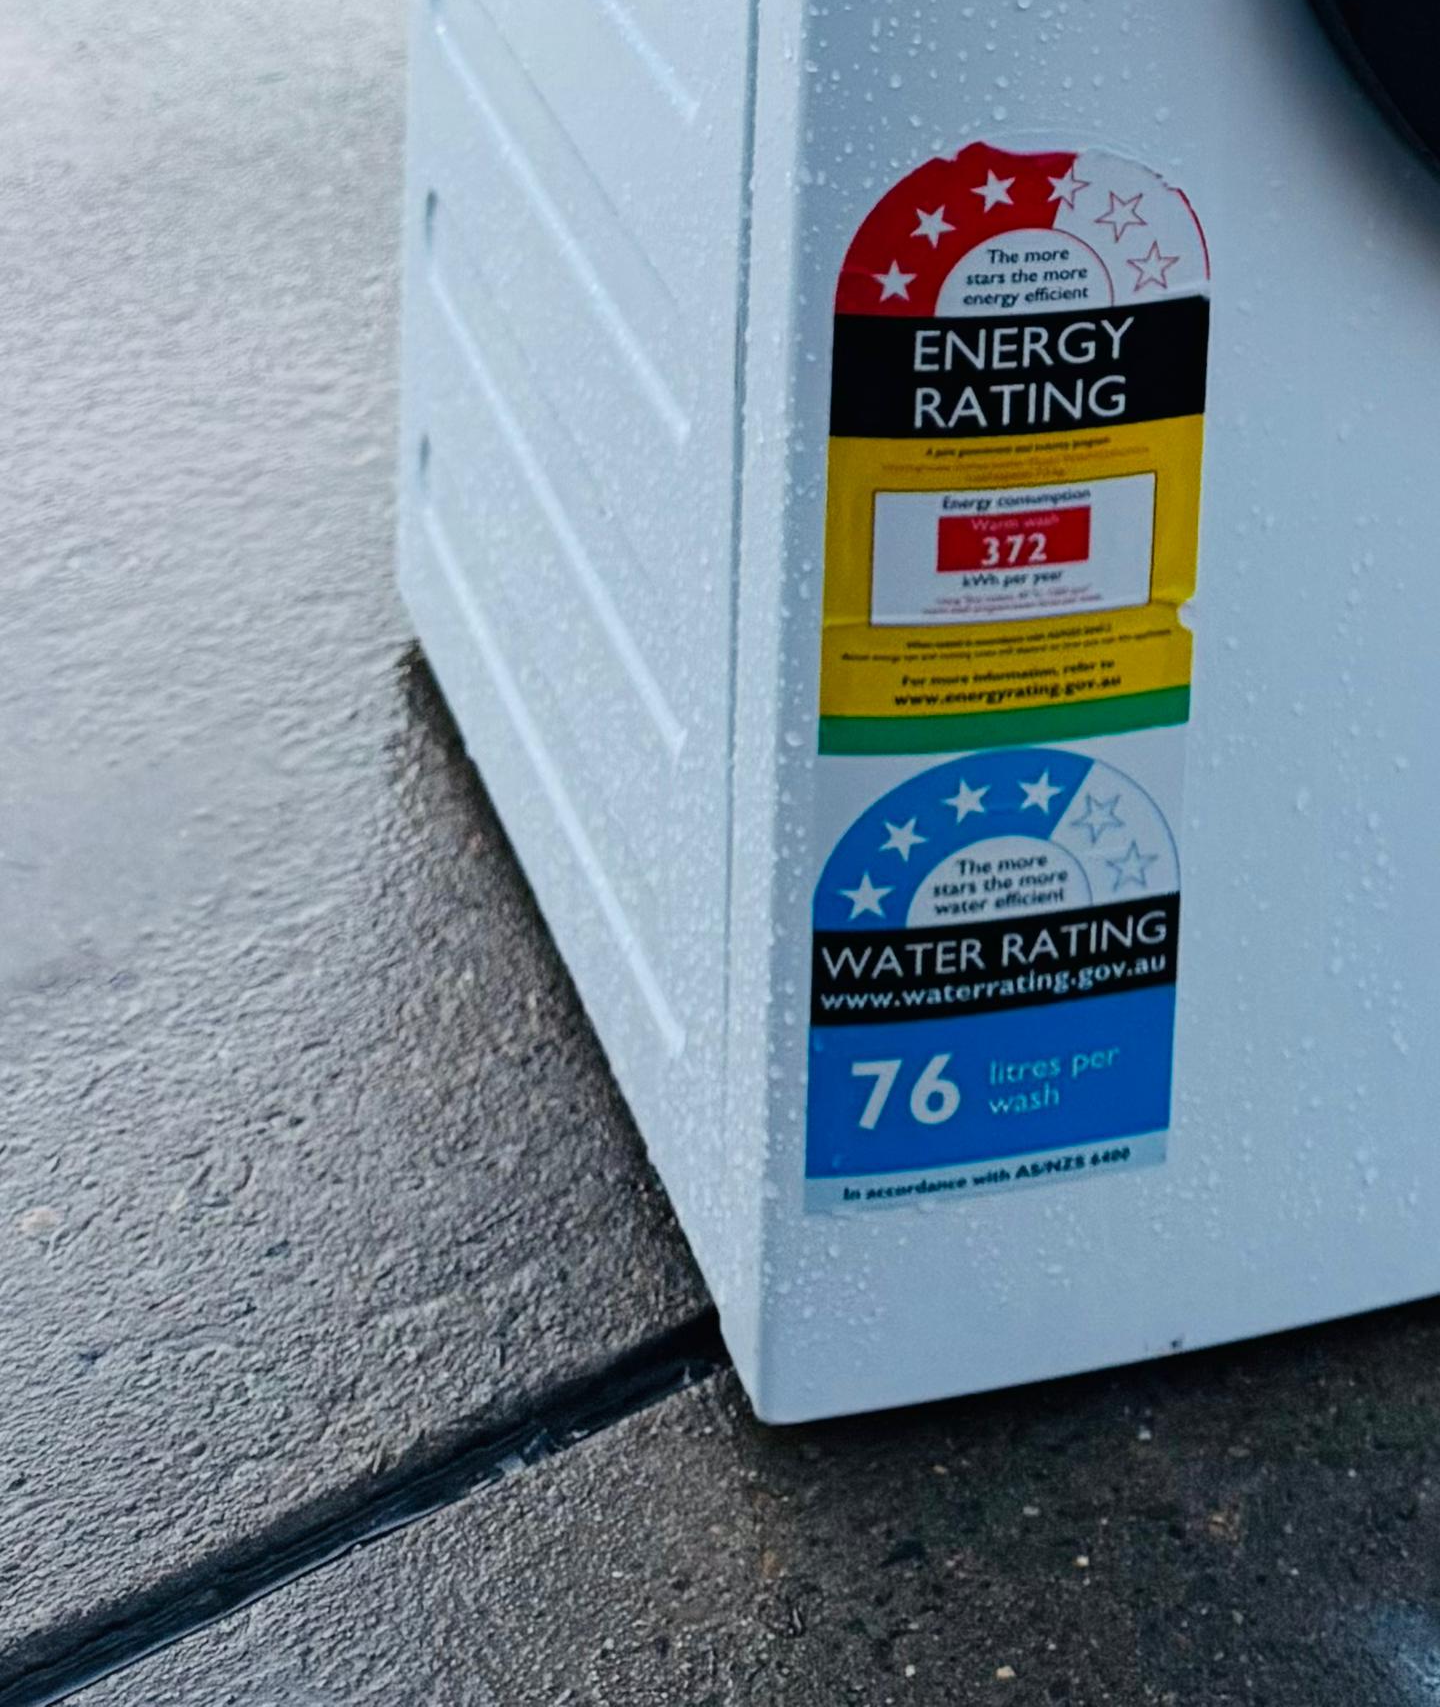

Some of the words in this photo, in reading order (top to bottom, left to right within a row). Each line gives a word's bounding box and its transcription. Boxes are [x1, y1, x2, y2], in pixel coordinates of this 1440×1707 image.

[986, 248, 1021, 266] The
[1024, 247, 1070, 264] more
[966, 270, 1006, 287] stars
[1010, 268, 1040, 285] the
[1042, 266, 1088, 282] more
[962, 290, 1020, 310] energy
[1023, 286, 1089, 306] efficient
[912, 316, 1135, 373] ENERGY
[912, 375, 1128, 430] RATING
[942, 494, 993, 512] Energy
[997, 489, 1092, 508] consumption
[971, 517, 1020, 532] Warm
[980, 532, 1048, 568] 372
[962, 572, 1000, 588] kWh
[1002, 573, 1028, 589] per
[1033, 570, 1064, 586] year
[894, 675, 1122, 708] www.energyrating.gov.au
[901, 674, 927, 688] For
[930, 673, 970, 688] more
[955, 857, 995, 877] The
[998, 854, 1048, 872] more
[933, 881, 979, 899] stars
[983, 874, 1015, 893] the
[1018, 870, 1068, 887] more
[934, 899, 990, 917] water
[994, 889, 1066, 911] efficient
[820, 937, 986, 982] WATER
[1000, 910, 1168, 968] RATING
[819, 955, 1166, 1011] www.waterrating.gov.au
[850, 1052, 962, 1131] 76
[989, 1055, 1062, 1087] litres
[1070, 1046, 1121, 1080] per
[988, 1082, 1060, 1115] wash
[842, 1186, 862, 1201] In
[865, 1177, 968, 1200] accordance
[971, 1169, 1011, 1187] with
